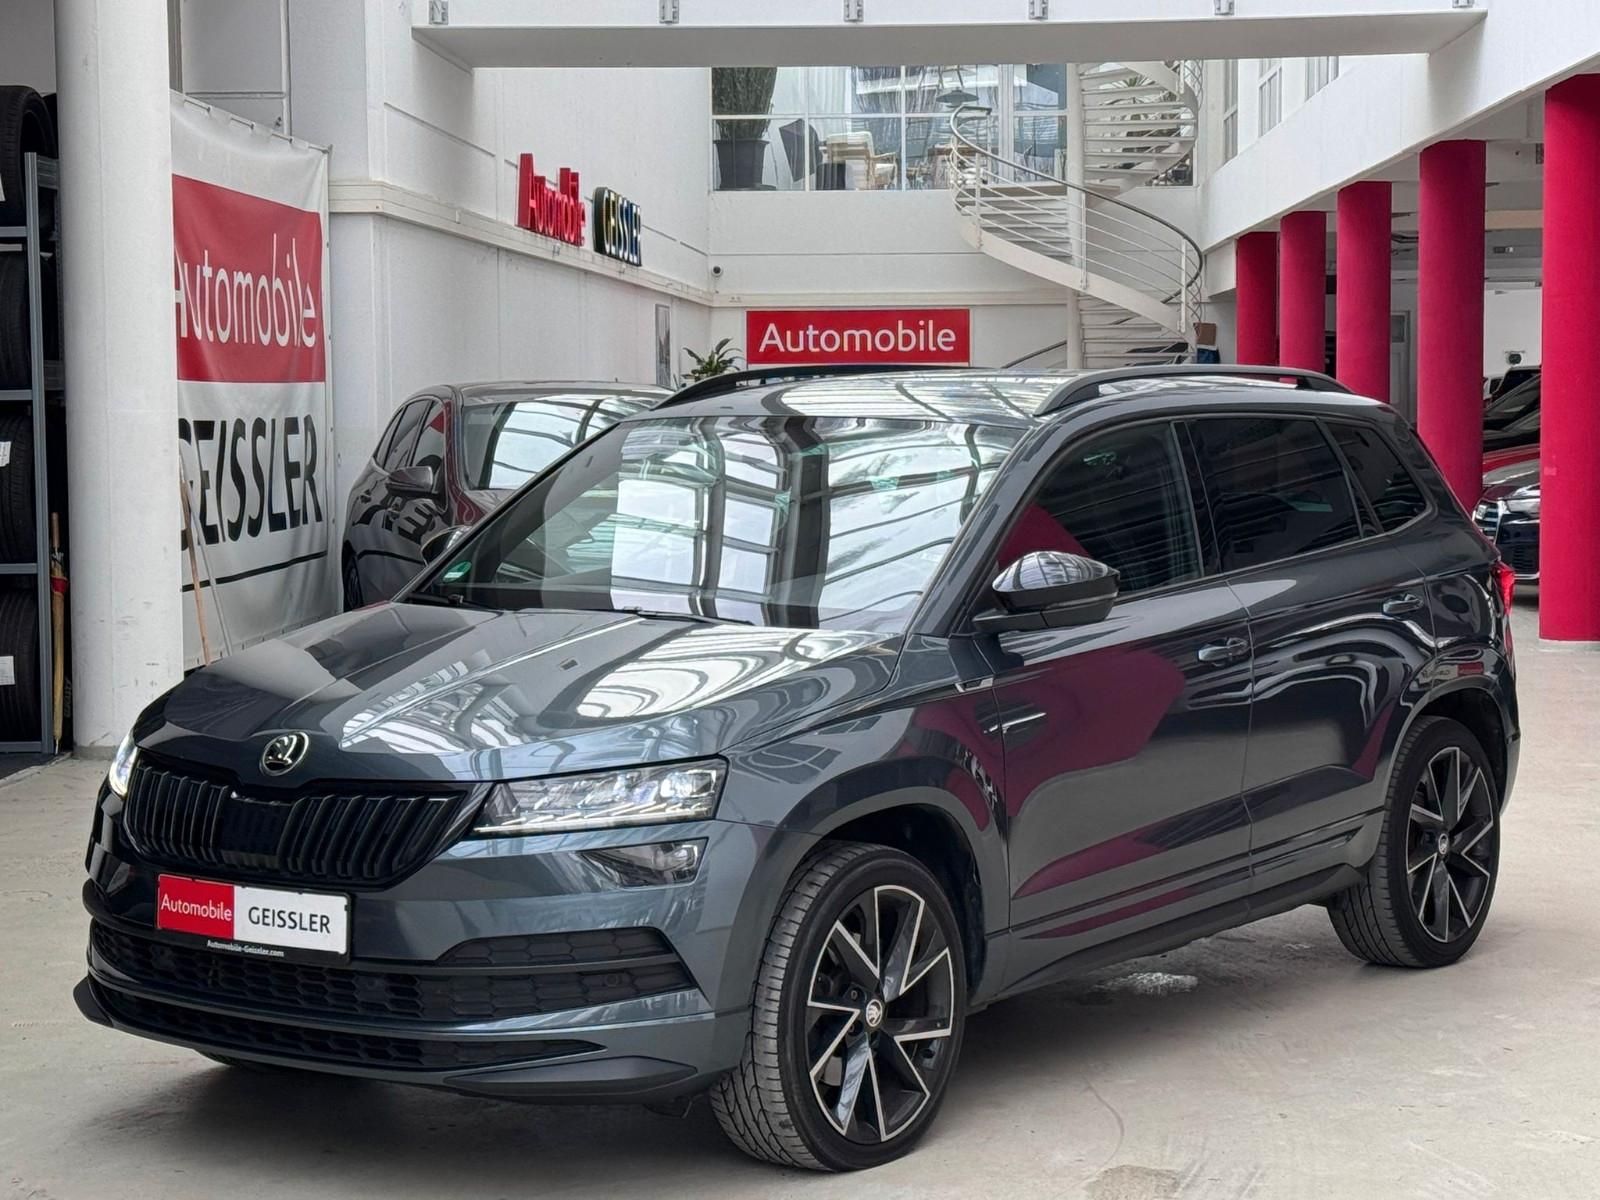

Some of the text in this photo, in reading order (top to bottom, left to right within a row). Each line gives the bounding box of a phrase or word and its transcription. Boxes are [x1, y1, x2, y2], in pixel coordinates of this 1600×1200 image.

[758, 319, 957, 353] Automobile
[160, 893, 331, 934] Automobile GEISSLER
